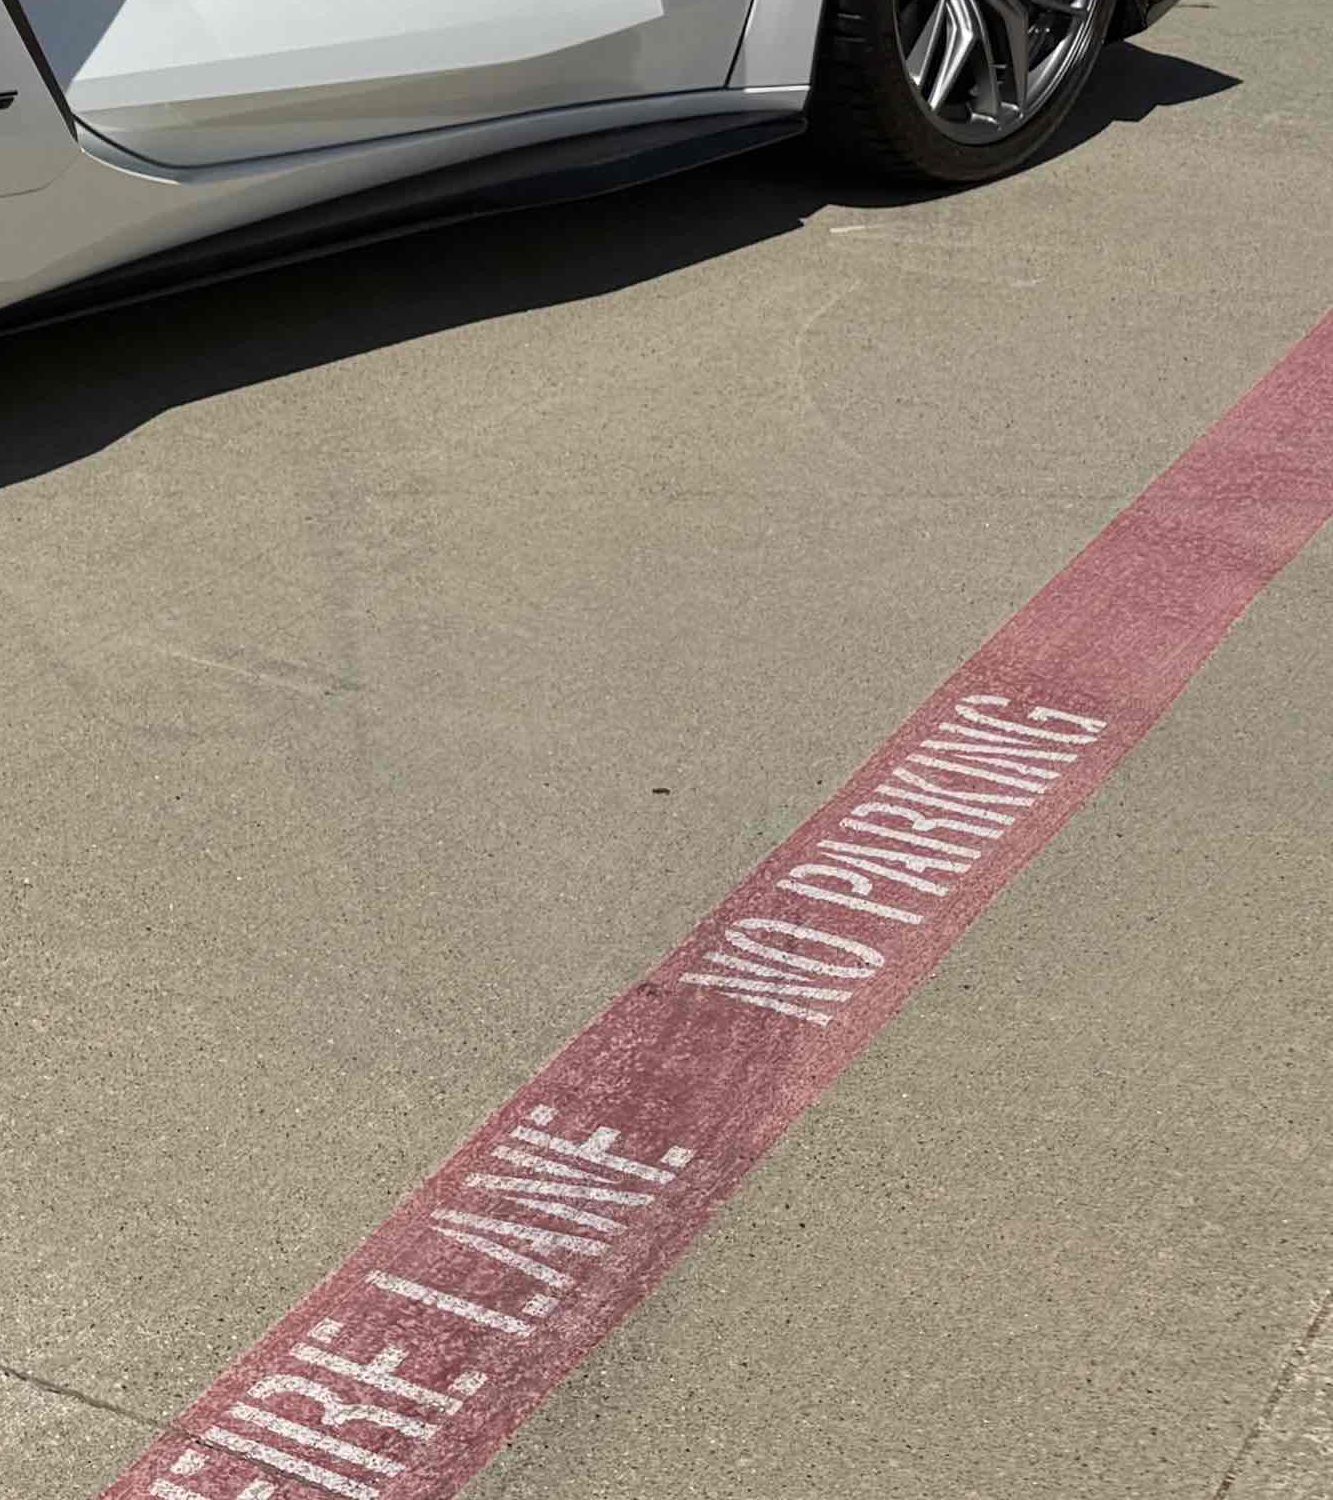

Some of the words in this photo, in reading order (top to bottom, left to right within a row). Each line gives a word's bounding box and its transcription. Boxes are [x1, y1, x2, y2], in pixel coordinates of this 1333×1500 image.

[777, 694, 1107, 925] PARKING
[678, 917, 884, 1026] NO
[365, 1104, 694, 1337] LANE
